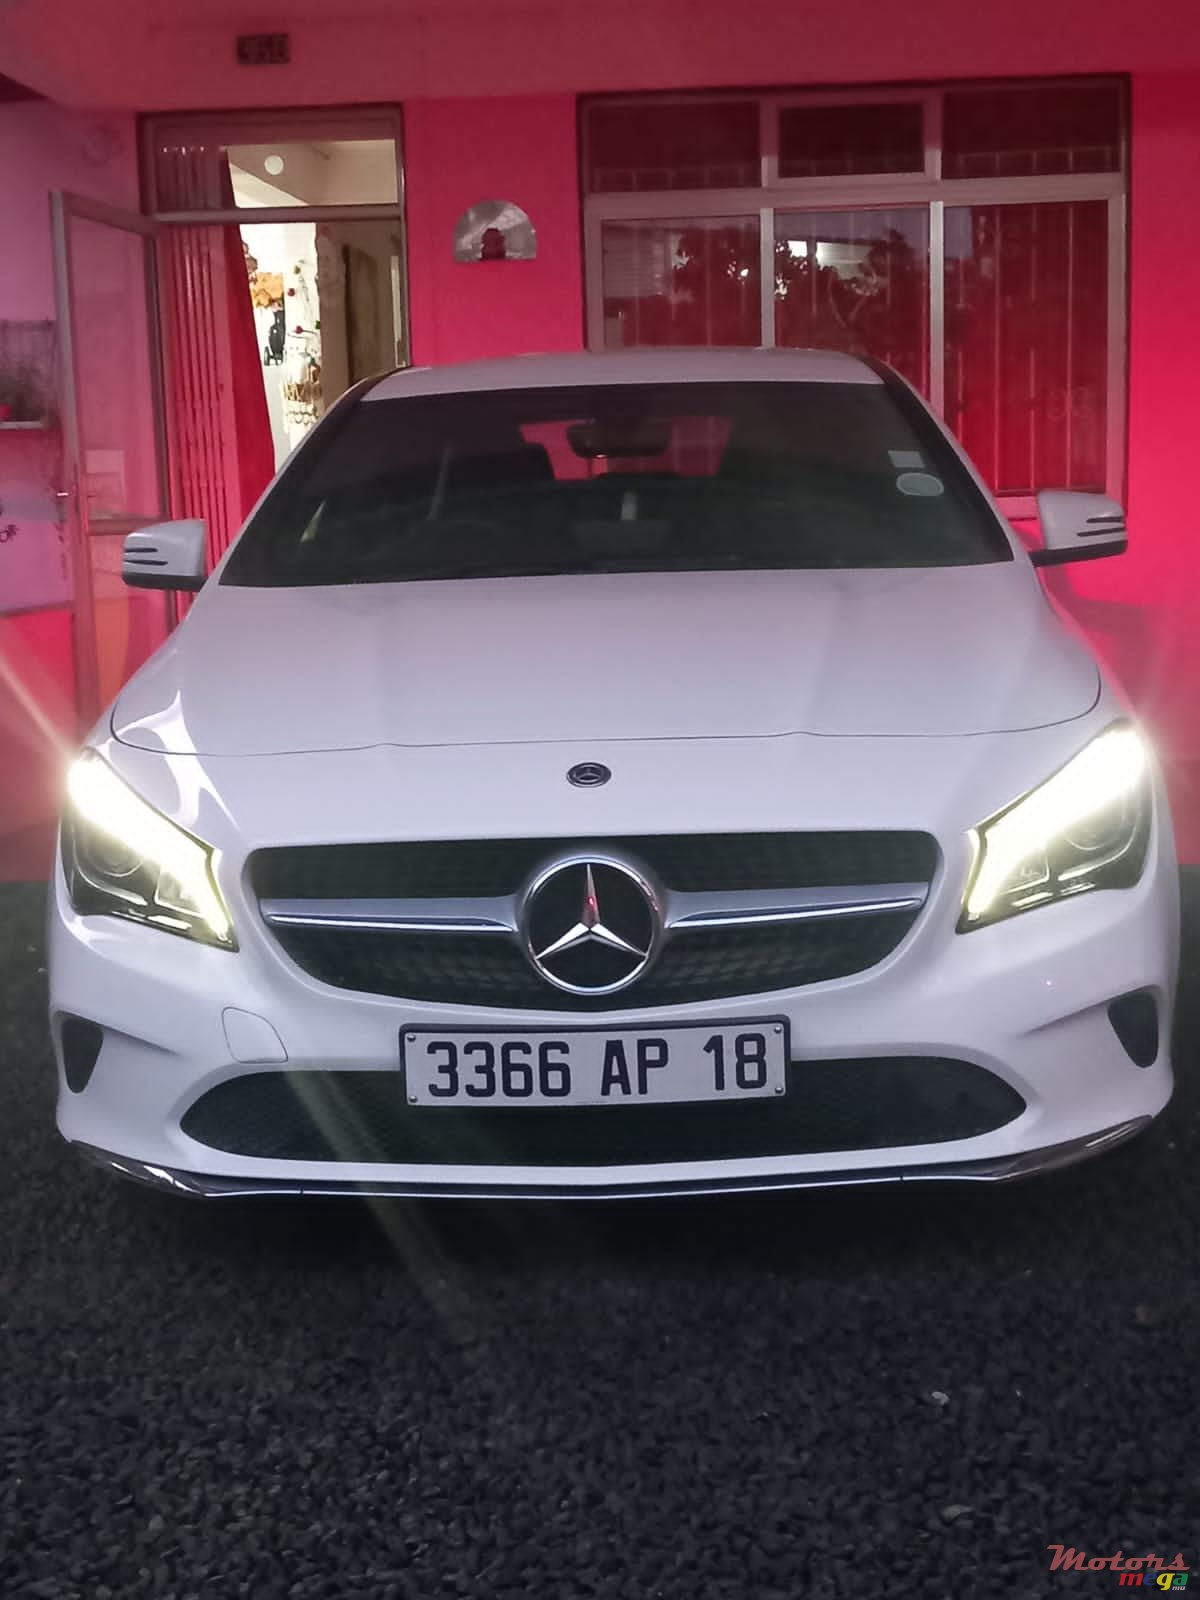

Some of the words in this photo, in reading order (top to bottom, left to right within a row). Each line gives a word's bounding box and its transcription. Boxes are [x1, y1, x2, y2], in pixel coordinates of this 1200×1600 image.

[427, 1041, 572, 1098] 3366
[600, 1038, 669, 1096] AP
[703, 1033, 767, 1091] 18
